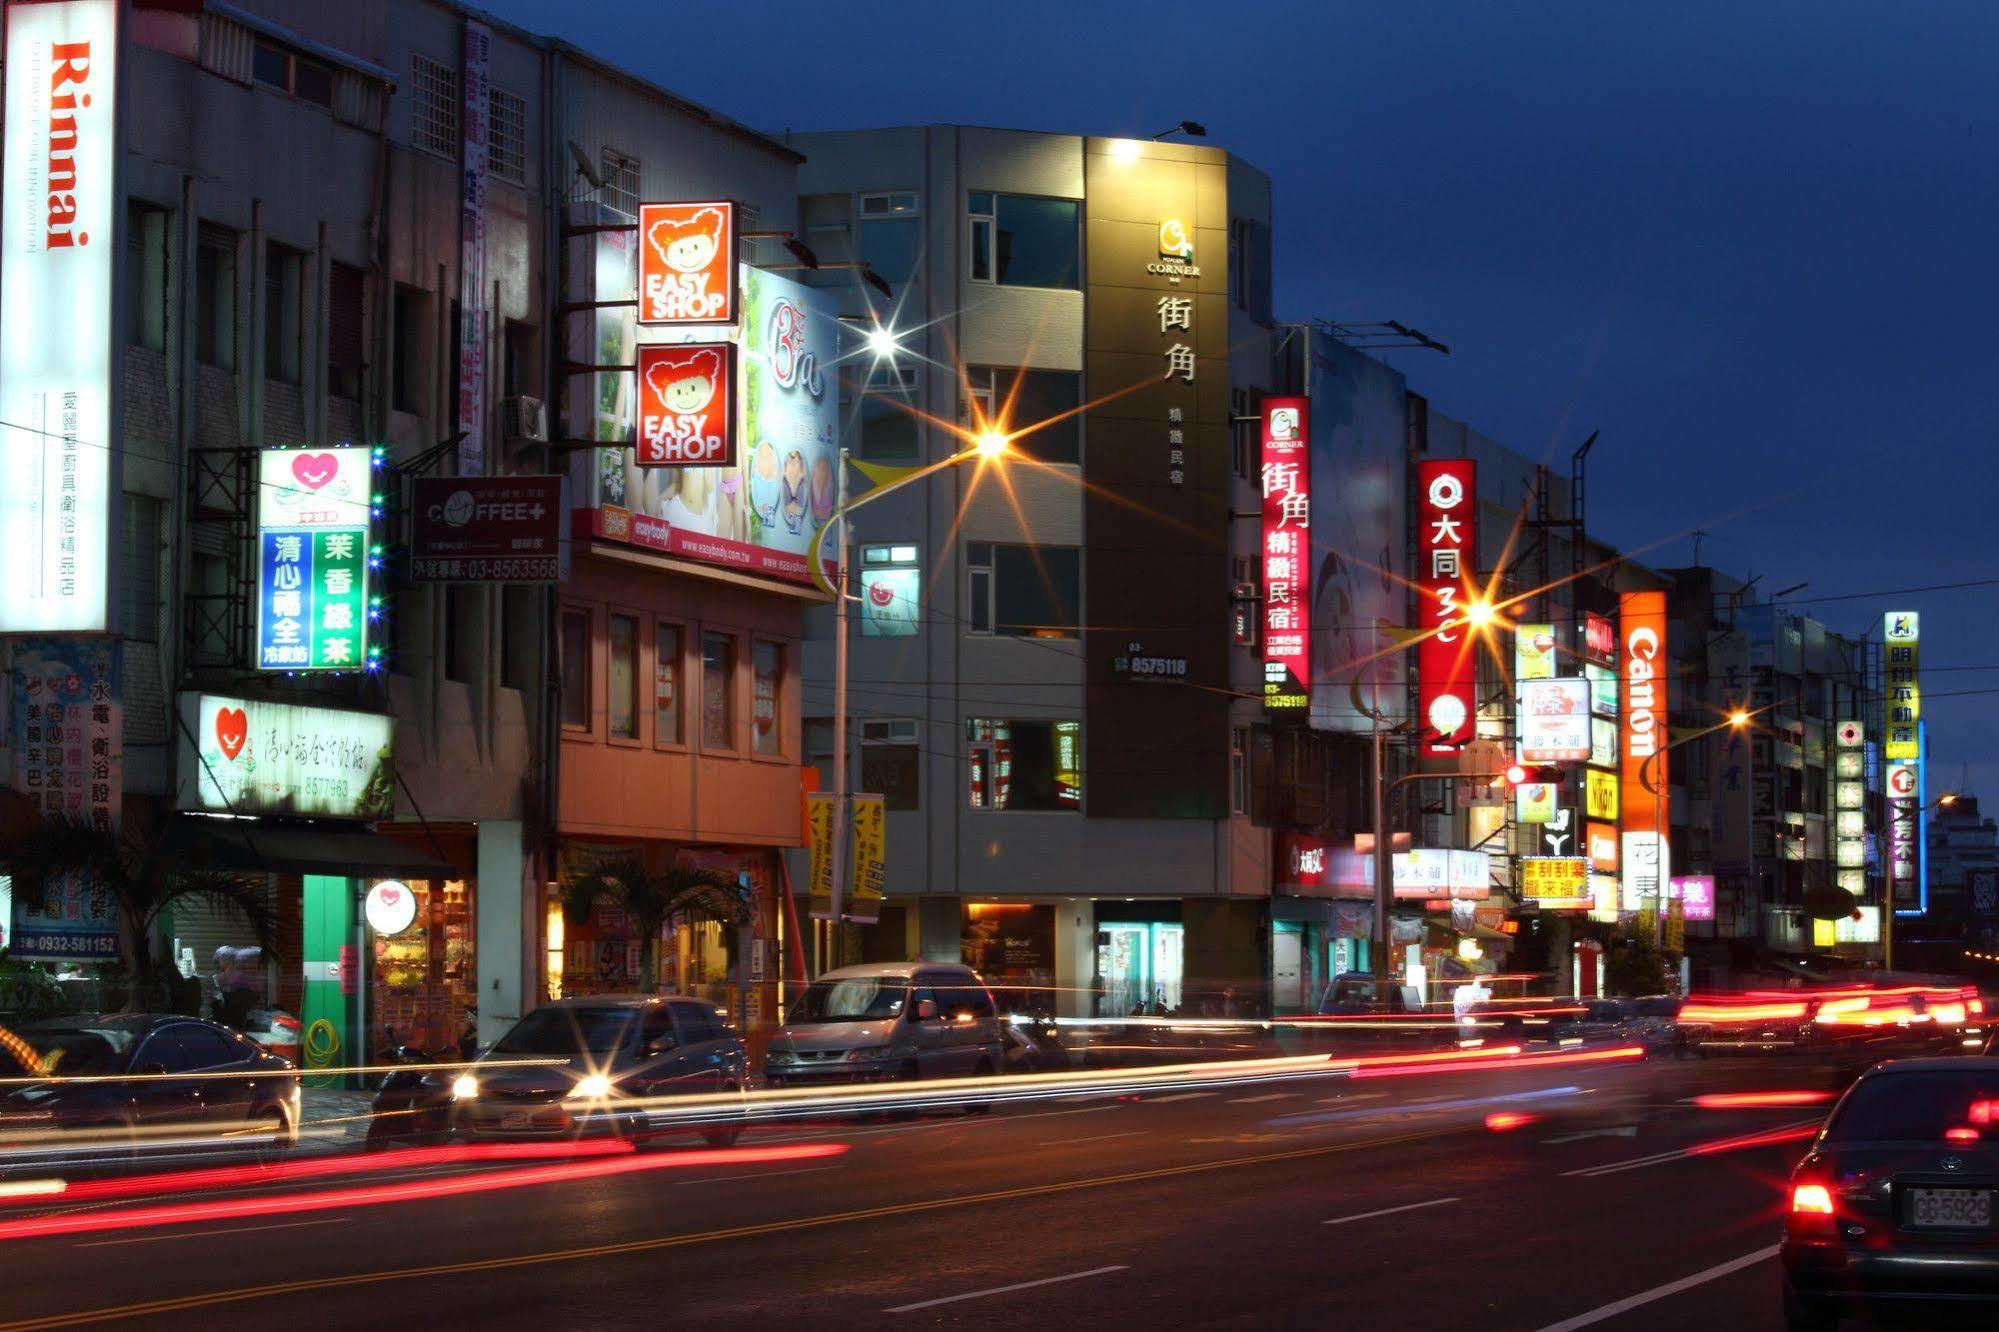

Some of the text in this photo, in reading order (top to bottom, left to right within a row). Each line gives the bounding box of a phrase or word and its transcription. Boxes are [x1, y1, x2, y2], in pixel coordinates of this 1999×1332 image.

[47, 40, 92, 251] Rinnai
[26, 167, 38, 254] INNOVATION
[646, 273, 711, 298] EASY
[1147, 263, 1201, 277] CORNER
[652, 293, 725, 319] SHOP
[1158, 296, 1197, 382] 街角
[643, 415, 708, 440] EASY
[650, 436, 722, 460] SHOP
[1266, 441, 1304, 450] CORNER
[1260, 462, 1311, 529] 街角
[273, 535, 302, 644] 清心福全
[1267, 531, 1291, 630] 精緻民宿
[322, 534, 354, 664] 茉香綠茶
[1131, 656, 1188, 675] 8575118
[1628, 626, 1660, 757] Canon
[1591, 778, 1613, 812] Nikon
[38, 937, 116, 954] 0932-581152
